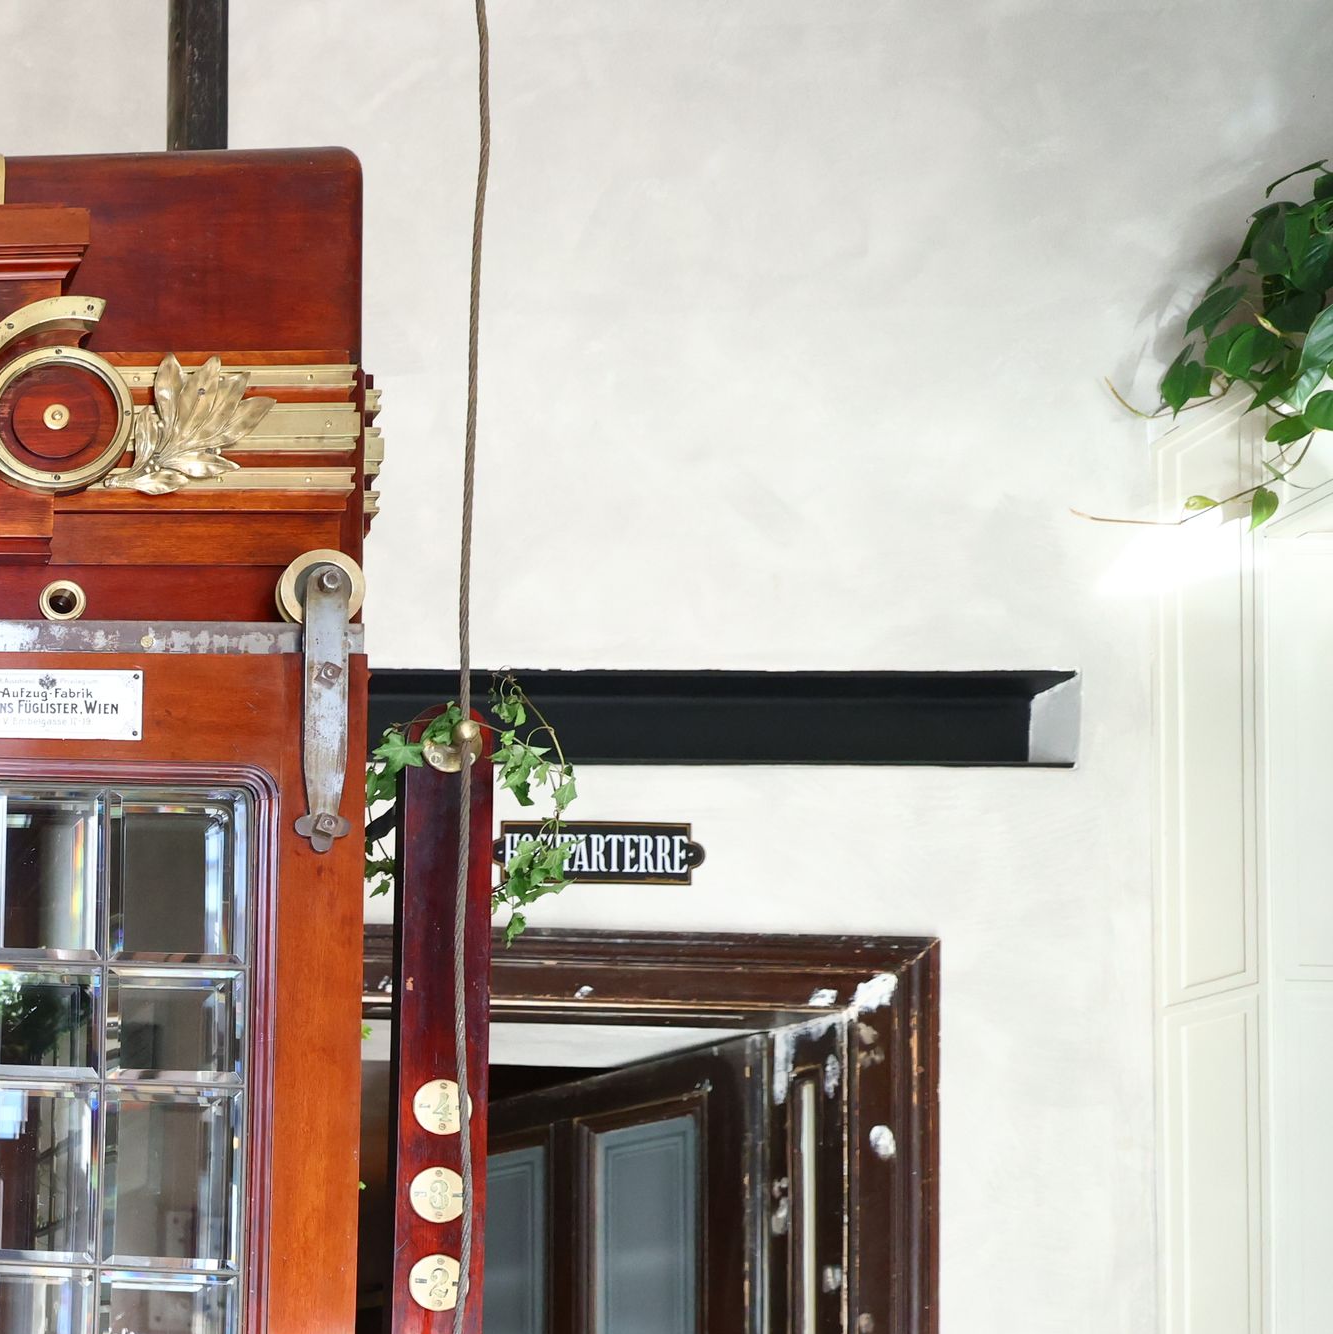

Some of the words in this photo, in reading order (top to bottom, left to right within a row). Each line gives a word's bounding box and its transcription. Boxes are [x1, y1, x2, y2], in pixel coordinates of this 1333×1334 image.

[0, 688, 93, 702] Aufzug-Fabrik
[84, 700, 119, 715] WIEN
[504, 832, 689, 874] HPARTERRE
[433, 1092, 452, 1123] 4
[429, 1179, 449, 1210] 3
[429, 1268, 450, 1298] 2
